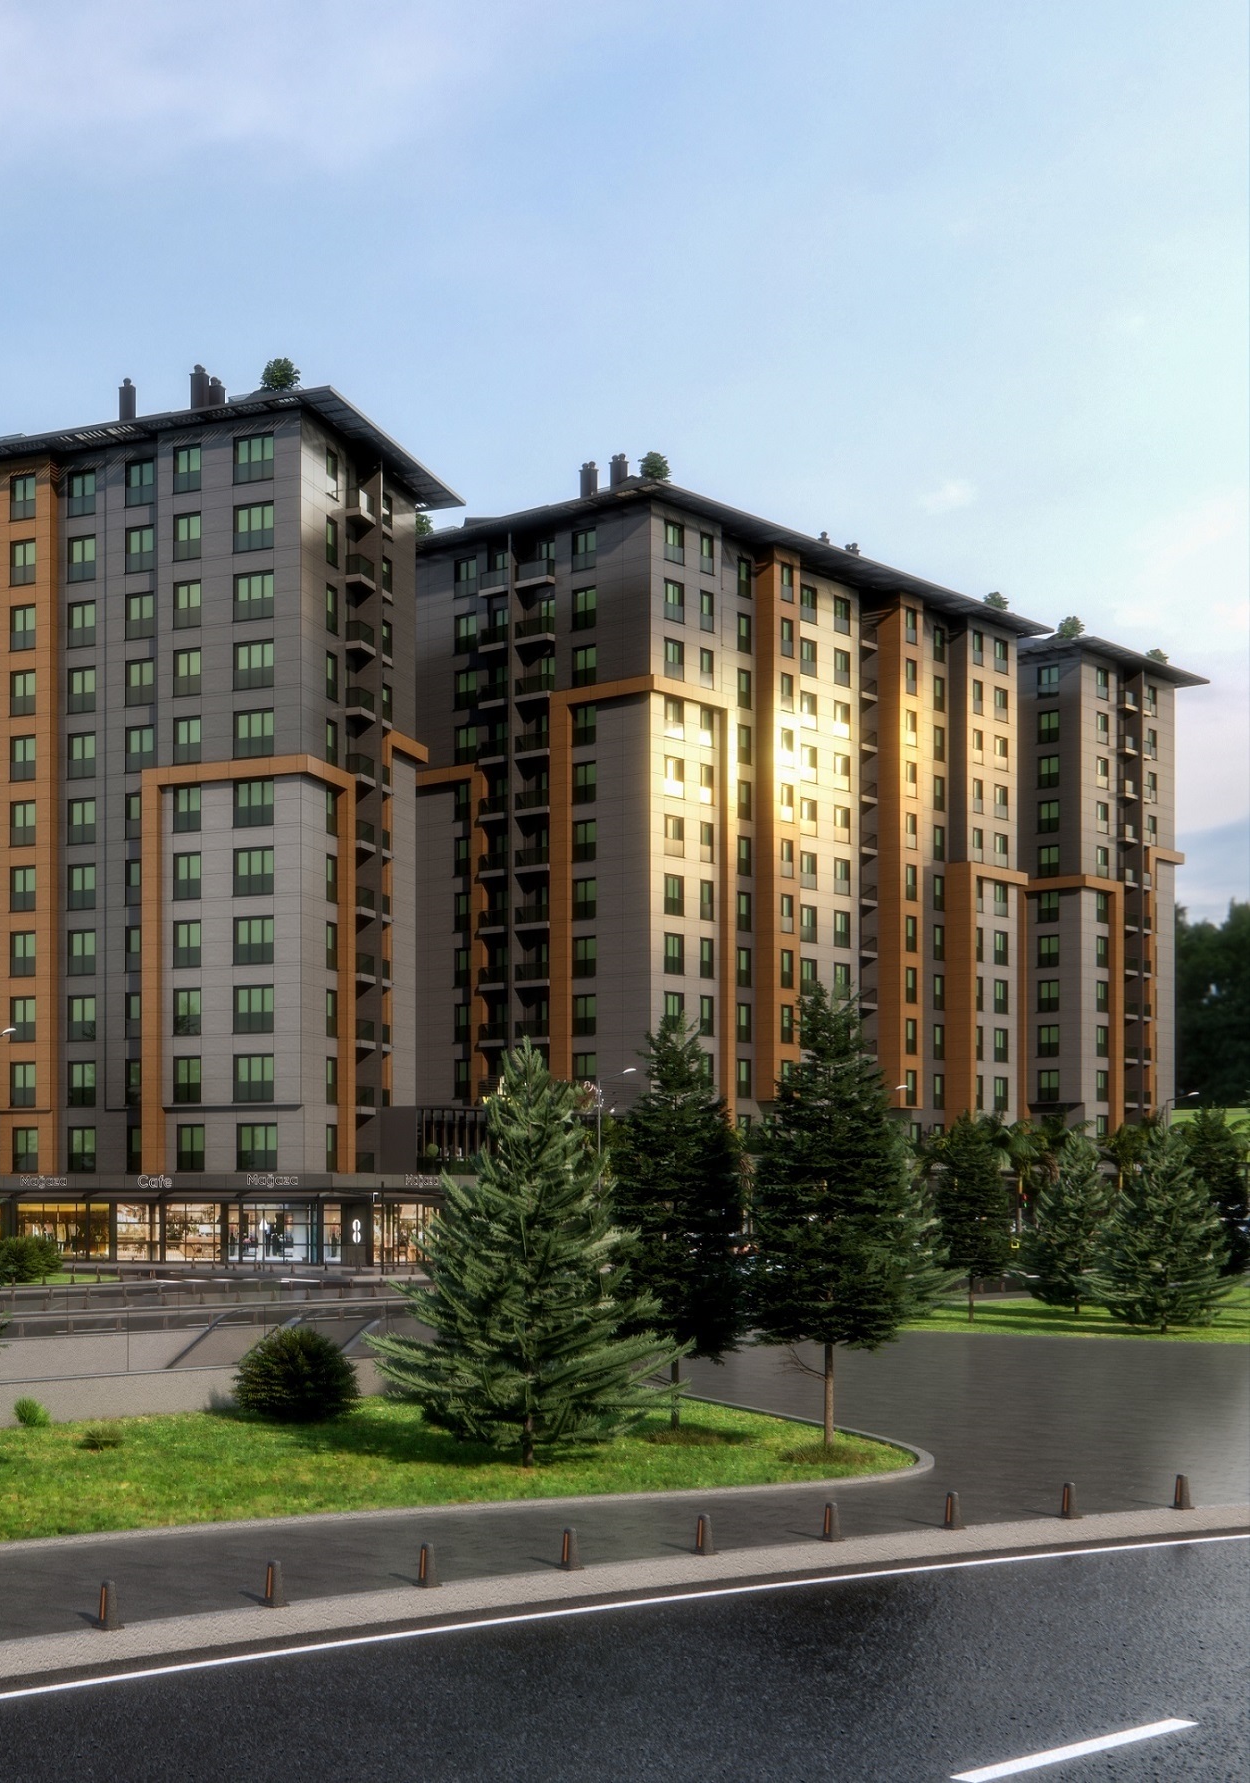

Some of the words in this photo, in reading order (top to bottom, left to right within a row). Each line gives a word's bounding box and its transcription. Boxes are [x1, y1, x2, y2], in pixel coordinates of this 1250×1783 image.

[19, 1175, 68, 1189] Mağaza
[137, 1174, 173, 1189] Cafe
[246, 1173, 299, 1189] Mağaza
